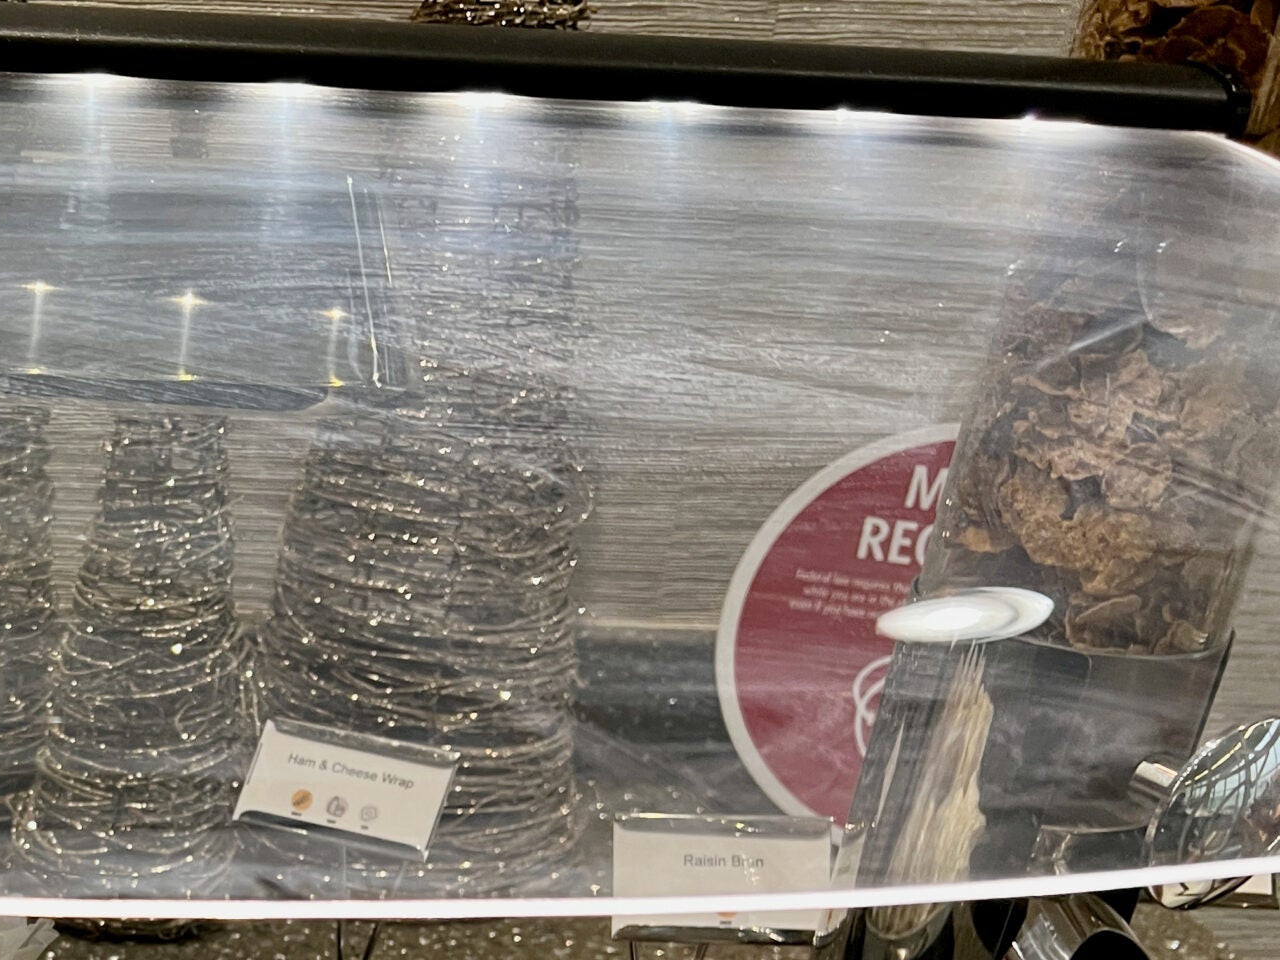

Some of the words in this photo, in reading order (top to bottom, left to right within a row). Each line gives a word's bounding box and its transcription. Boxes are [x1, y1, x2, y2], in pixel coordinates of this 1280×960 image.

[288, 752, 316, 769] Ham
[318, 760, 328, 771] &
[331, 761, 379, 782] Cheese
[381, 771, 415, 790] Wrap
[683, 853, 727, 868] Raisin
